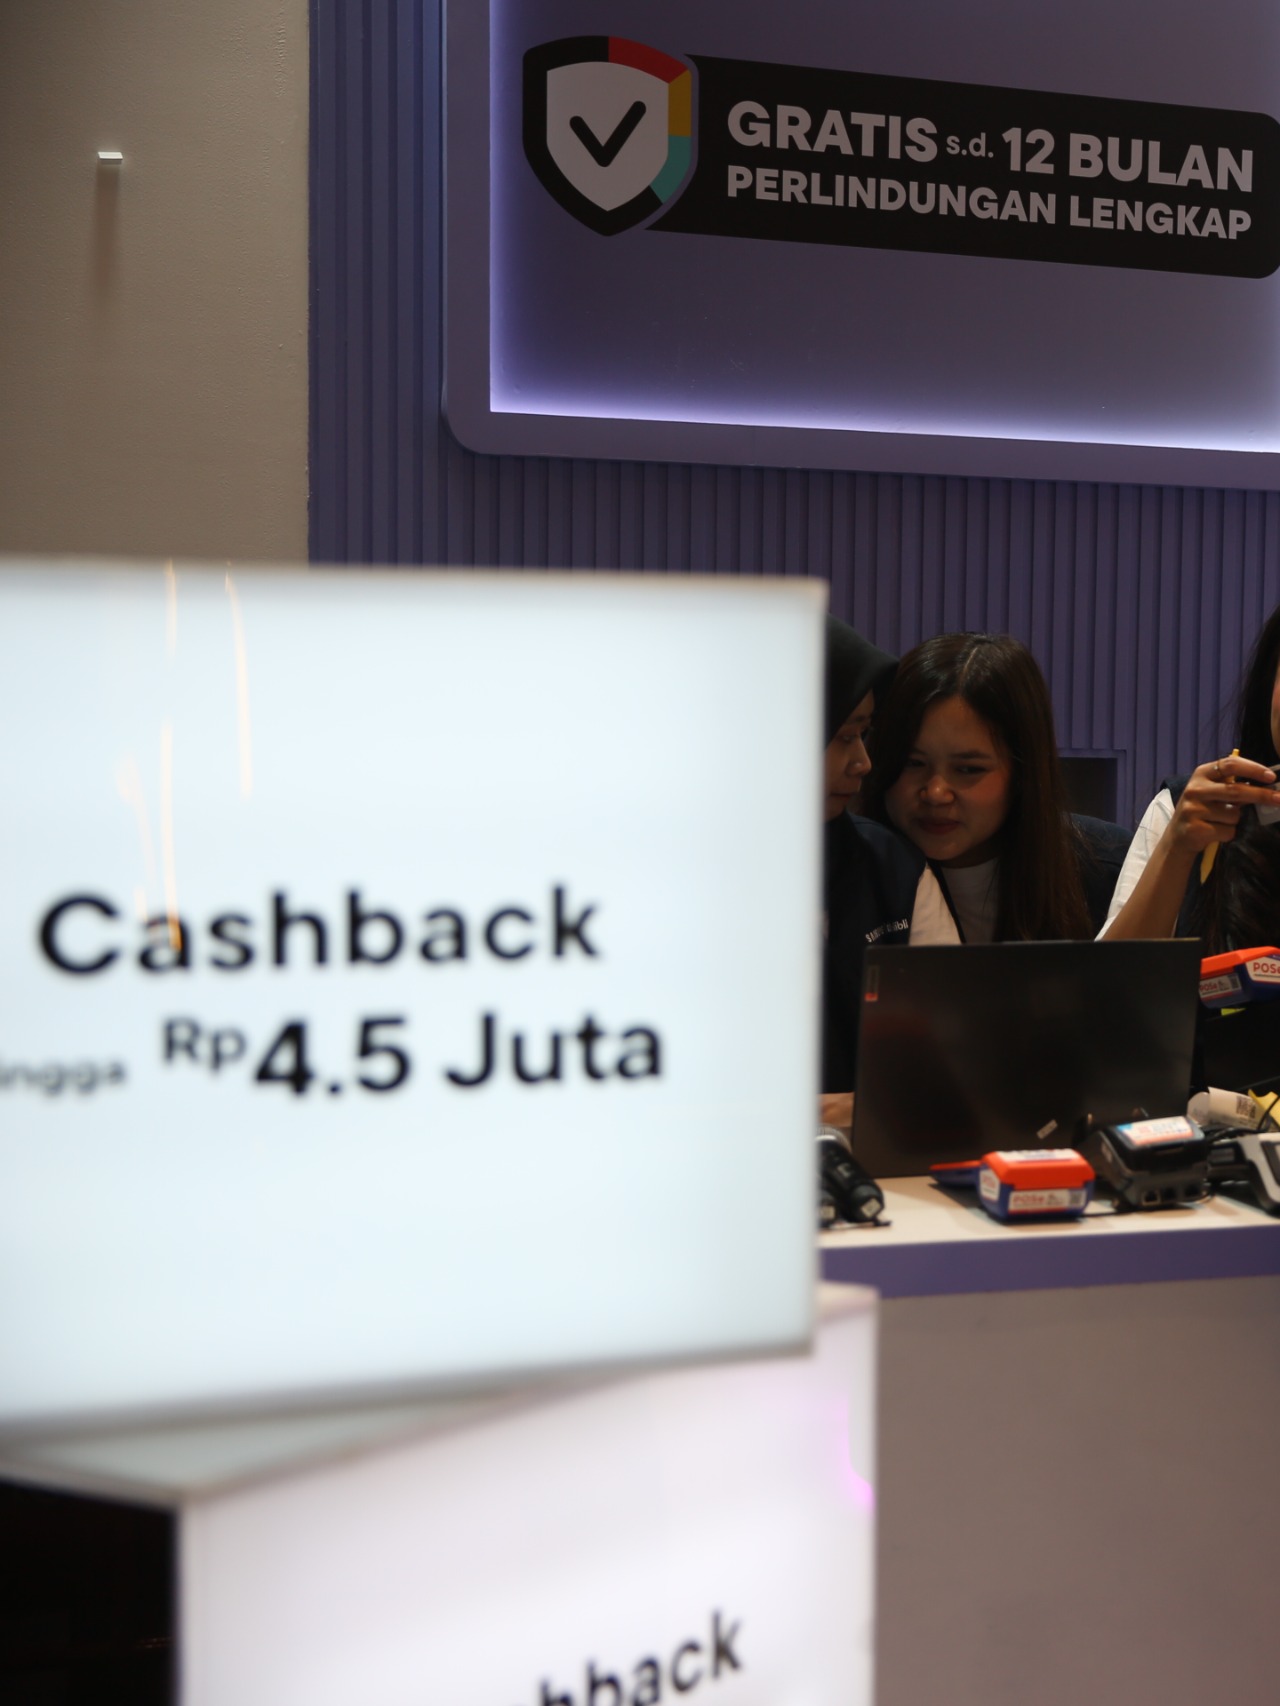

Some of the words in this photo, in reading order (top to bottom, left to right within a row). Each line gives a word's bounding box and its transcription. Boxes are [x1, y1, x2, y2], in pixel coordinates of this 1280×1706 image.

[727, 100, 938, 163] GRATIS
[945, 132, 994, 158] s.d.
[1002, 127, 1055, 175] 12
[1068, 132, 1254, 193] BULAN
[727, 164, 1056, 225] PERLINDUNGAN
[1069, 195, 1252, 240] LENGKAP
[36, 885, 599, 978] Cashback
[445, 1012, 662, 1089] Juta
